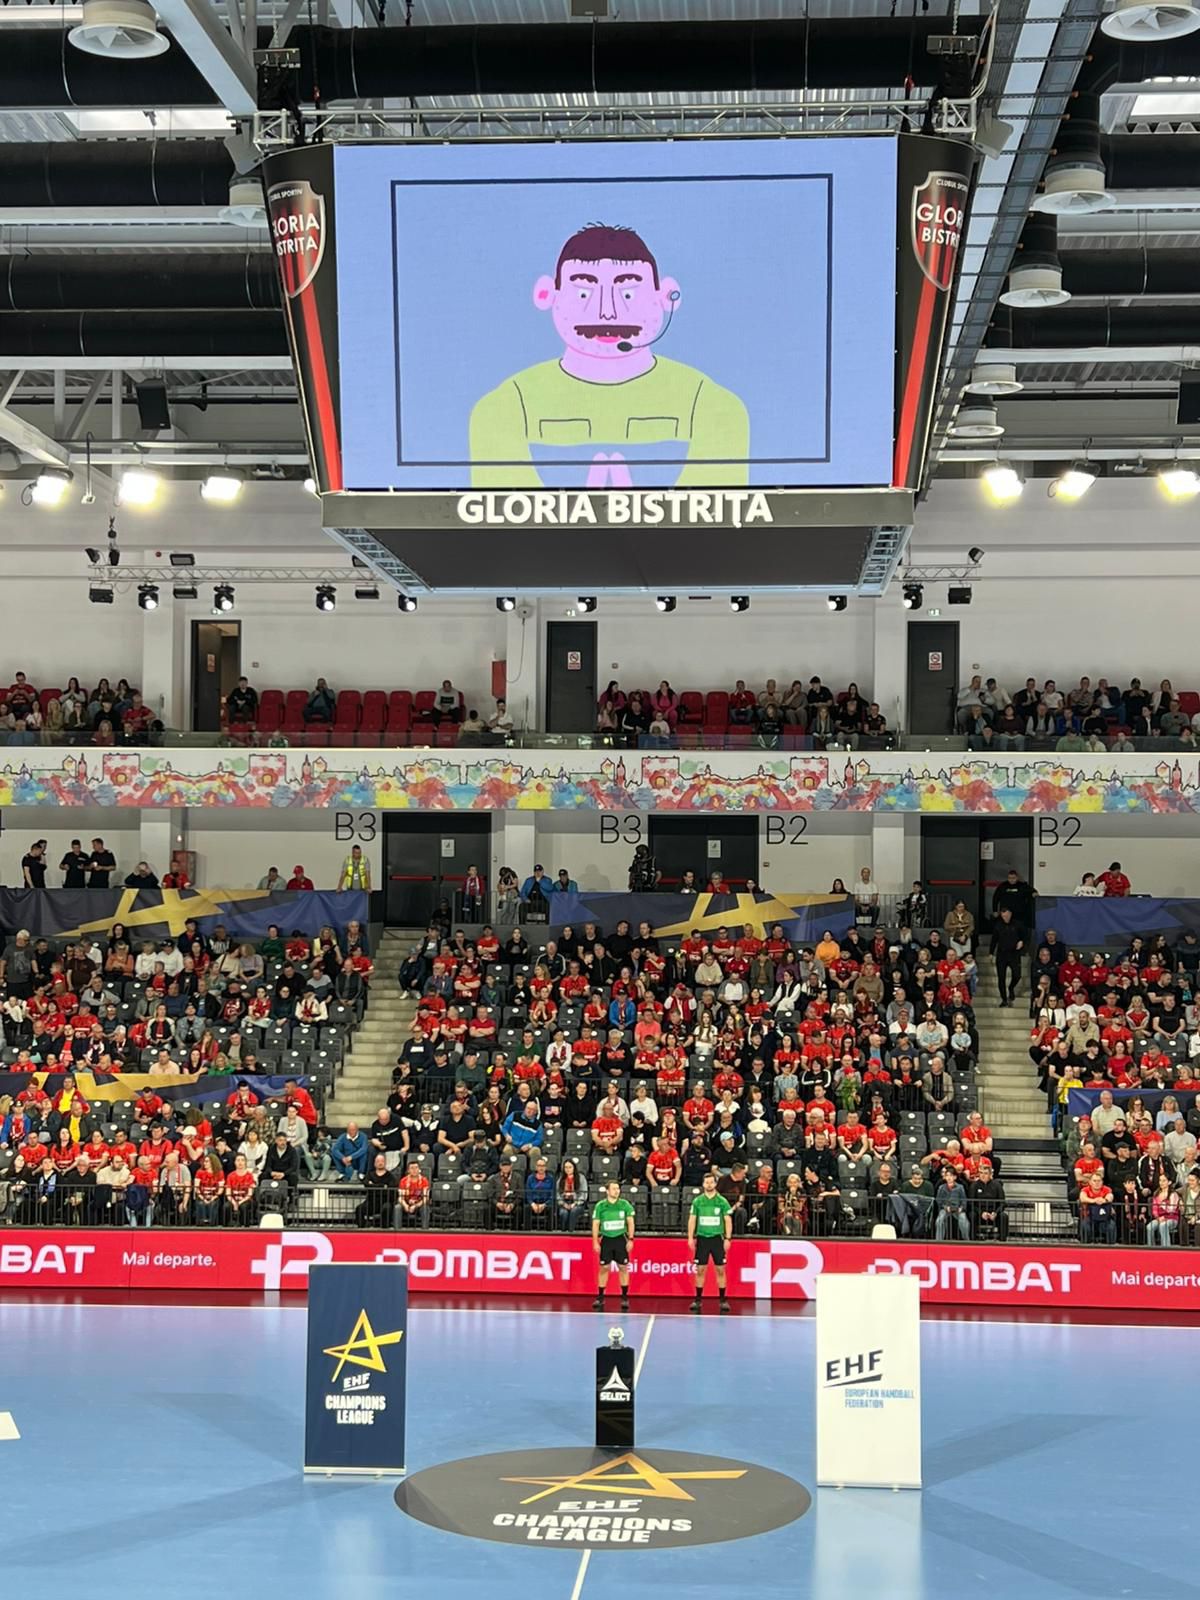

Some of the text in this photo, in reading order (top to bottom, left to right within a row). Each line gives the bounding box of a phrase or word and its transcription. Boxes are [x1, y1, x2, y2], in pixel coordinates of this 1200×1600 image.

[272, 212, 320, 237] LORIA
[457, 493, 598, 523] GLORIA
[335, 812, 376, 841] B3
[600, 815, 641, 844] B3
[766, 815, 809, 845] B2
[1038, 817, 1083, 847] B2
[0, 1244, 95, 1274] BAT
[122, 1252, 217, 1269] Mai departe.
[1111, 1270, 1140, 1286] Mai
[826, 1348, 883, 1381] EHF
[343, 1372, 371, 1390] EHF
[600, 1392, 631, 1402] SELECT
[845, 1388, 915, 1399] EUROPEAN HANDBALL
[325, 1395, 386, 1411] CHAMPIONS
[845, 1399, 884, 1408] FEDERATION
[336, 1410, 375, 1425] LEAGUE
[557, 1499, 643, 1511] EHF
[493, 1513, 693, 1532] CHAMPIONS
[527, 1527, 651, 1543] LEAGUE
